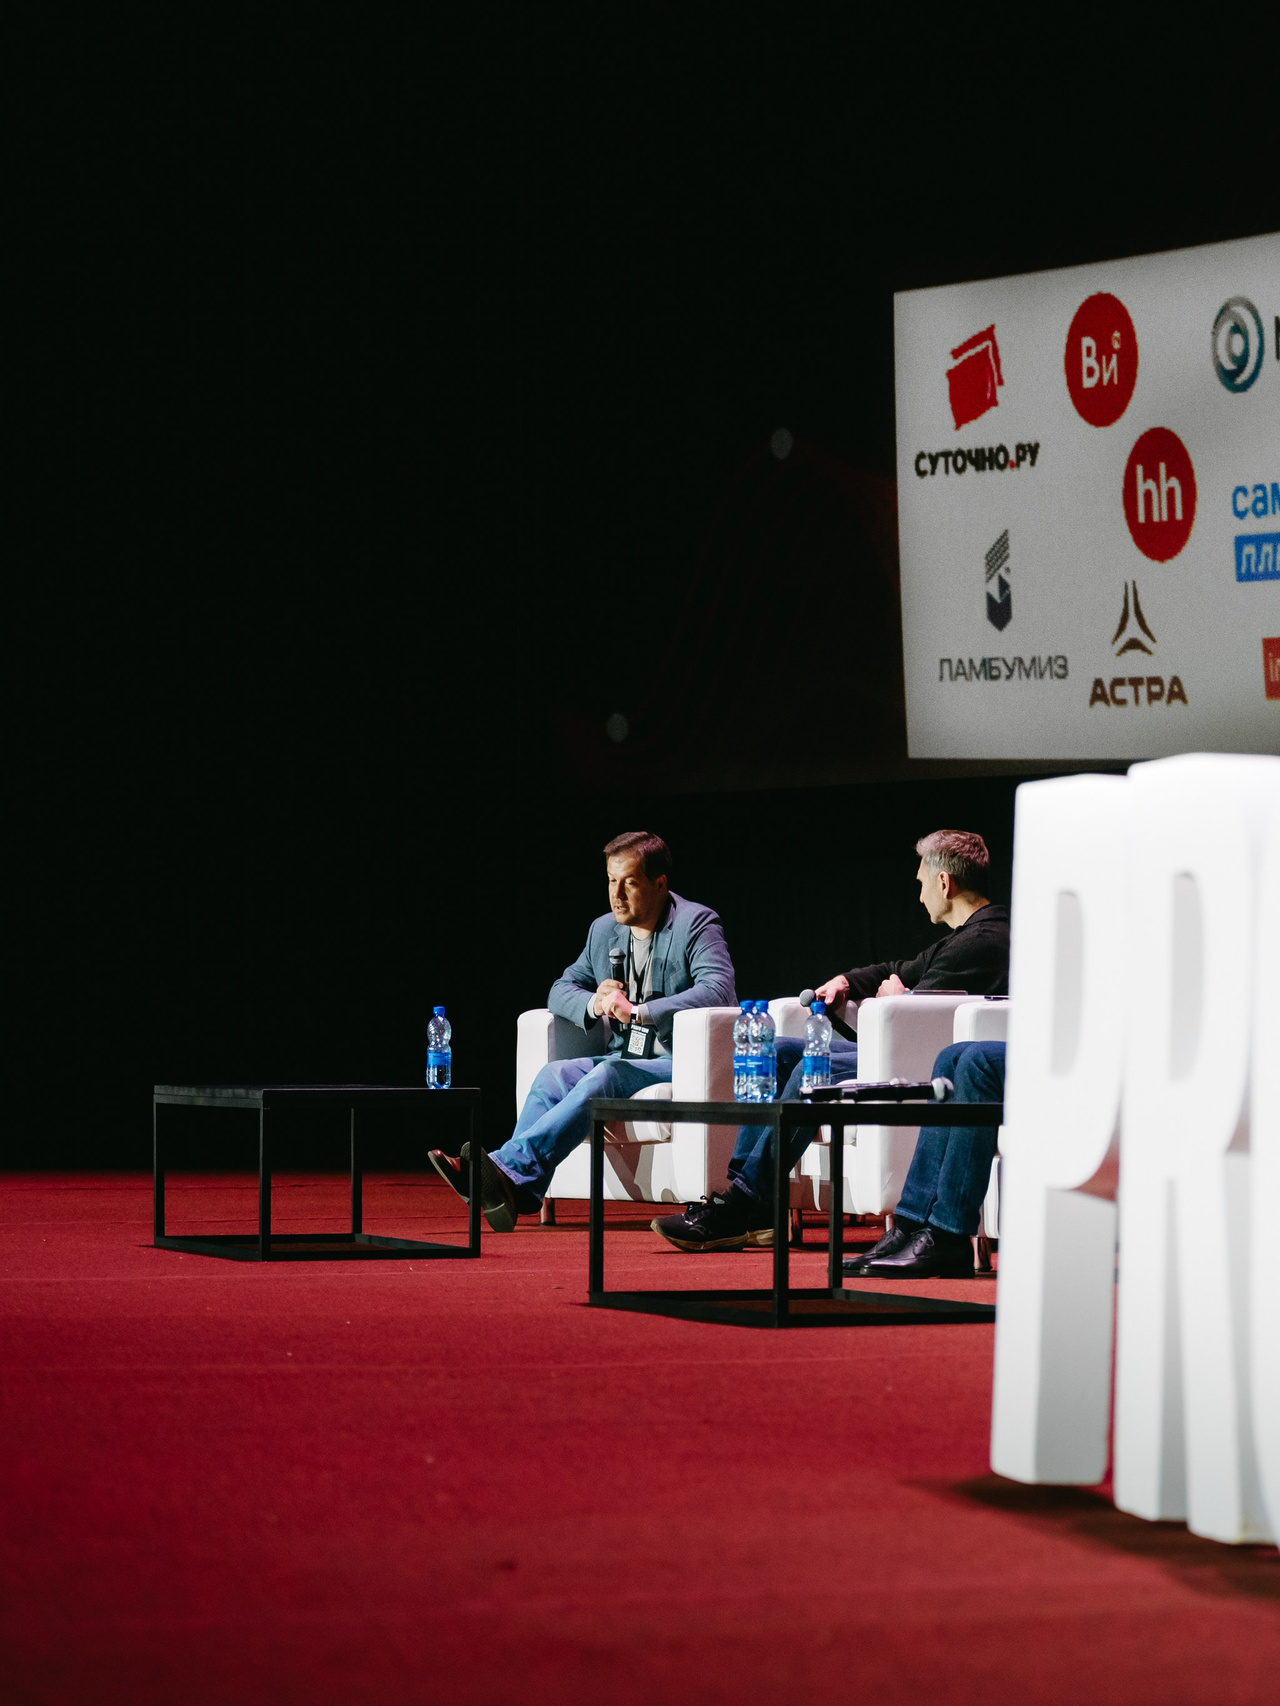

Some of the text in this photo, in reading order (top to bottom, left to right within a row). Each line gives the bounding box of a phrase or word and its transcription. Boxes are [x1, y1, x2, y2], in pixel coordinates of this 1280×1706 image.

[914, 441, 1041, 479] СУТОЧНО.РУ
[1136, 462, 1183, 524] hh
[1089, 674, 1189, 708] АСТРА
